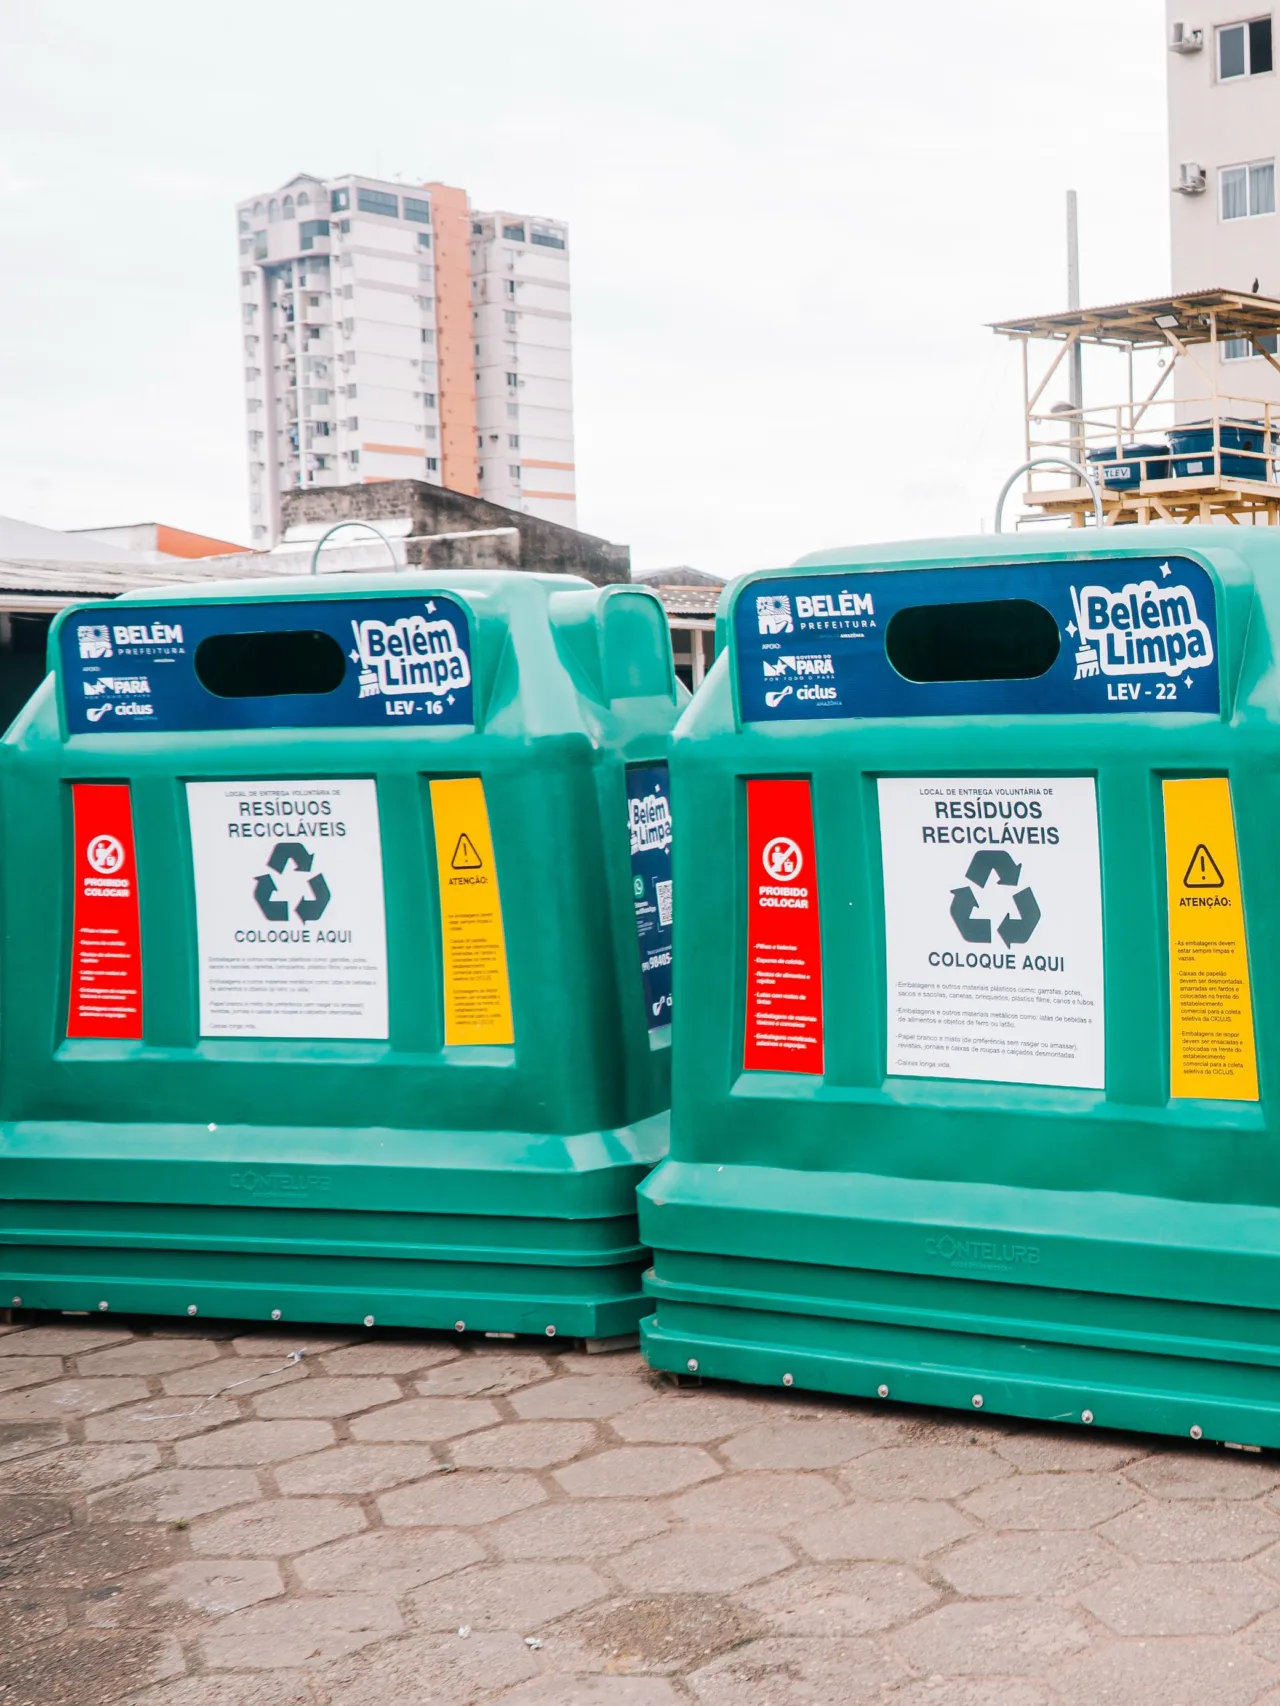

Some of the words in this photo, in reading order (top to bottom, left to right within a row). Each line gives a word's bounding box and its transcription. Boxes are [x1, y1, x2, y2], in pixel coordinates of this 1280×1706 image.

[796, 590, 874, 618] BELÉM
[1088, 591, 1191, 630] Belém
[113, 621, 184, 644] BELÉM
[801, 620, 876, 630] PREFEITURA
[367, 625, 452, 656] Belém
[1106, 630, 1206, 666] Limpa
[385, 656, 464, 686] Limpa
[796, 684, 837, 700] ciclus
[1107, 683, 1140, 700] LEV
[1156, 684, 1176, 700] 22
[115, 702, 154, 715] ciclus
[386, 701, 414, 715] LEV
[425, 700, 443, 714] 16
[995, 788, 1041, 796] VOLUNTÁRIA
[239, 798, 332, 816] RESÍDUOS
[634, 800, 666, 824] Belém
[935, 798, 1042, 818] RESÍDUOS
[228, 819, 346, 838] RECICLÁVEIS
[640, 821, 670, 844] Limpa
[922, 822, 1060, 844] RECICLÁVEIS
[84, 878, 128, 887] PROIBIDO
[449, 875, 488, 886] ATENÇÃO:
[84, 888, 129, 898] COLOCAR
[759, 886, 808, 898] PROIBIDO
[760, 898, 808, 909] COLOCAR
[1180, 896, 1231, 909] ATENÇÃO:
[234, 930, 310, 943] COLOQUE
[316, 930, 352, 943] AQUI
[928, 952, 1016, 970] COLOQUE
[1022, 955, 1064, 972] AQUI
